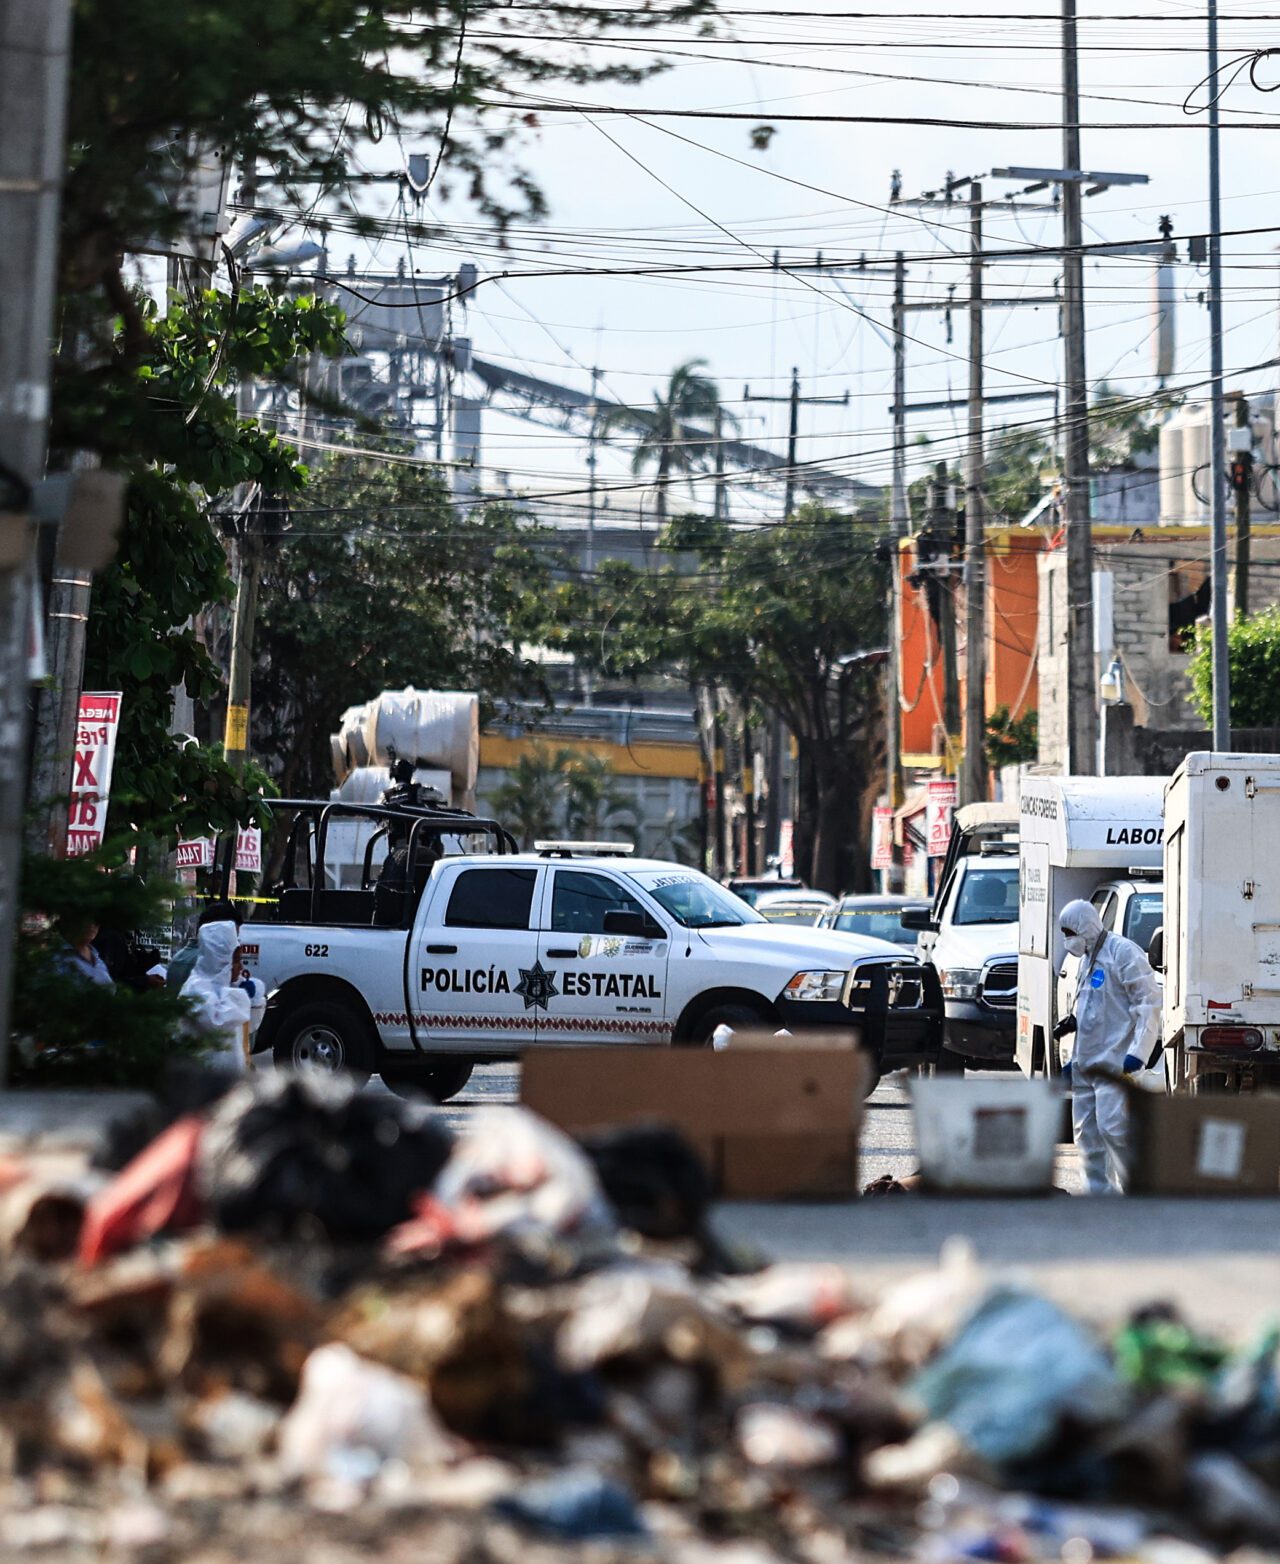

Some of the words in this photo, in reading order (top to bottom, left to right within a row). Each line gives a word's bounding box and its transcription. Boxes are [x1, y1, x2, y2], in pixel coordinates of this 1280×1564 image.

[1106, 827, 1164, 845] LABO
[305, 944, 329, 957] 622
[421, 964, 510, 993] POLICÍA
[562, 972, 661, 998] ESTATAL
